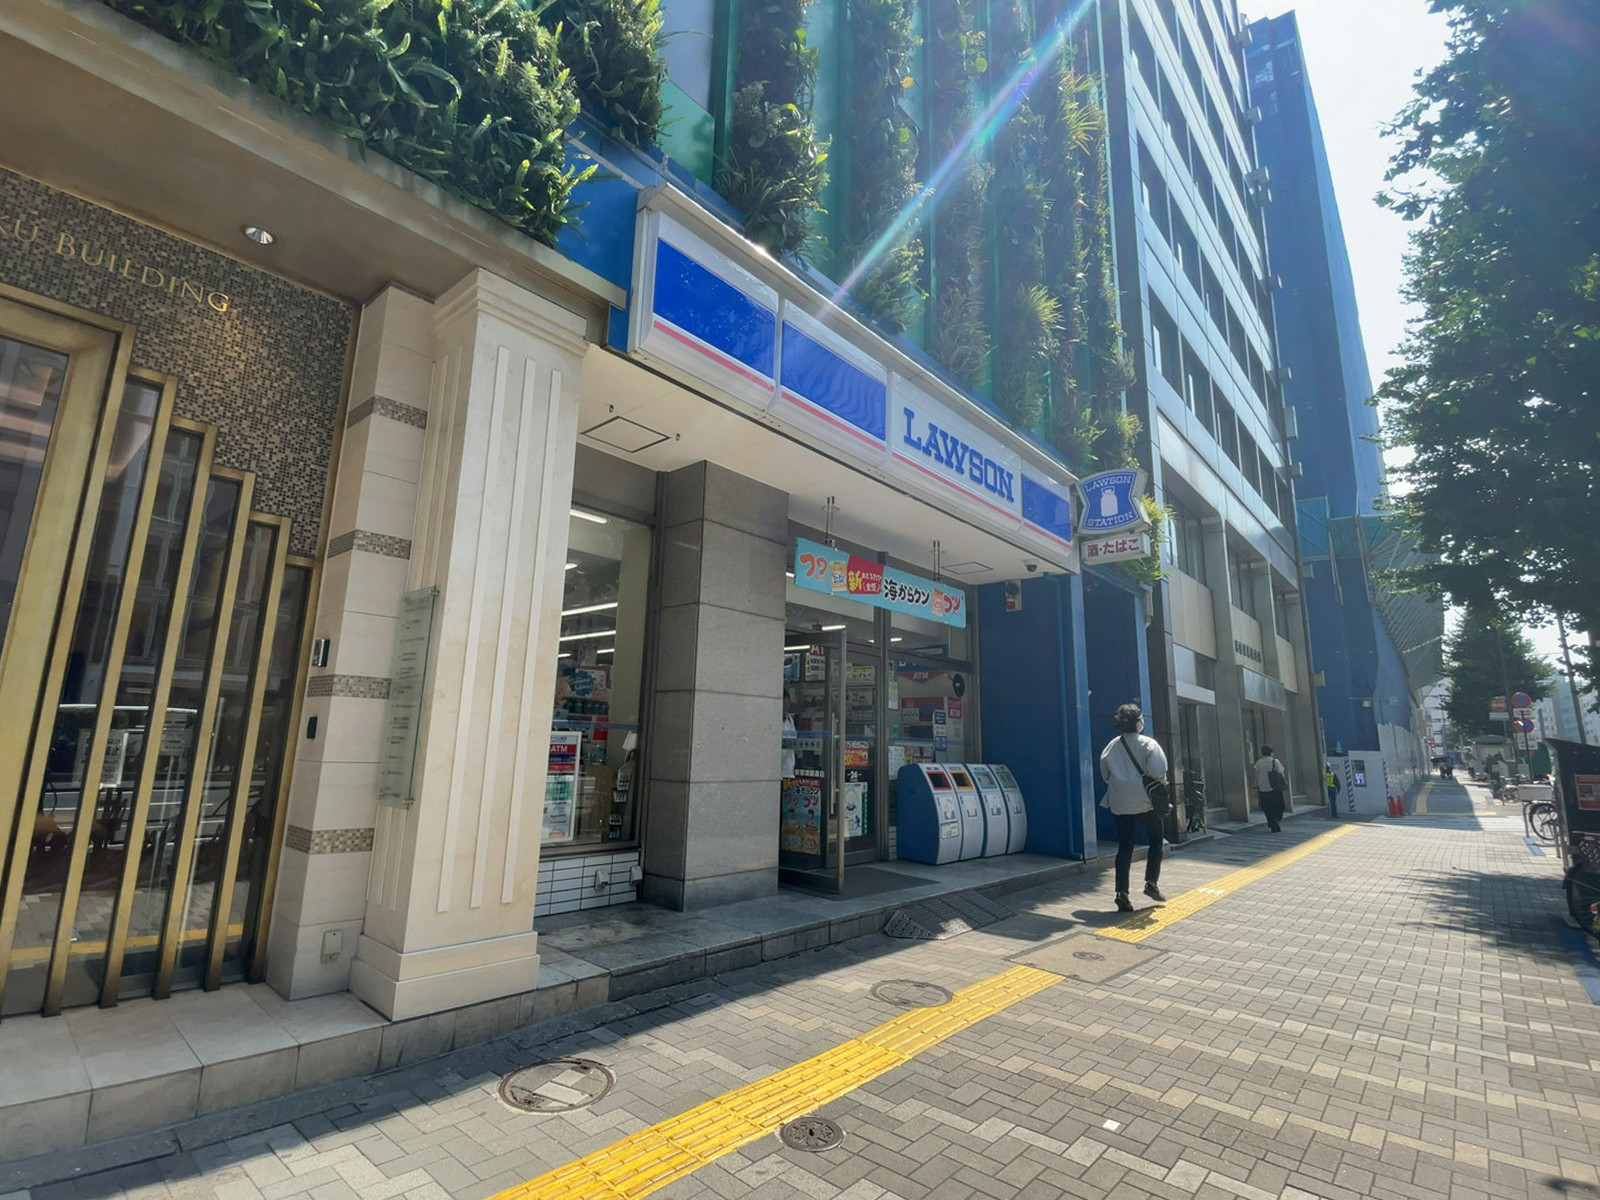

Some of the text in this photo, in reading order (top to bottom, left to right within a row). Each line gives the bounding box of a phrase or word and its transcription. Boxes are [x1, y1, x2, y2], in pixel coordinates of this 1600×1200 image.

[55, 232, 230, 313] BUILDING
[903, 406, 1015, 503] LAWSON
[1084, 475, 1132, 493] LAWSON
[1086, 511, 1134, 527] STATION
[1087, 538, 1140, 558] 酒・たばこ
[883, 577, 930, 605] 海からクン
[913, 672, 929, 680] ATM
[550, 745, 568, 753] ATM
